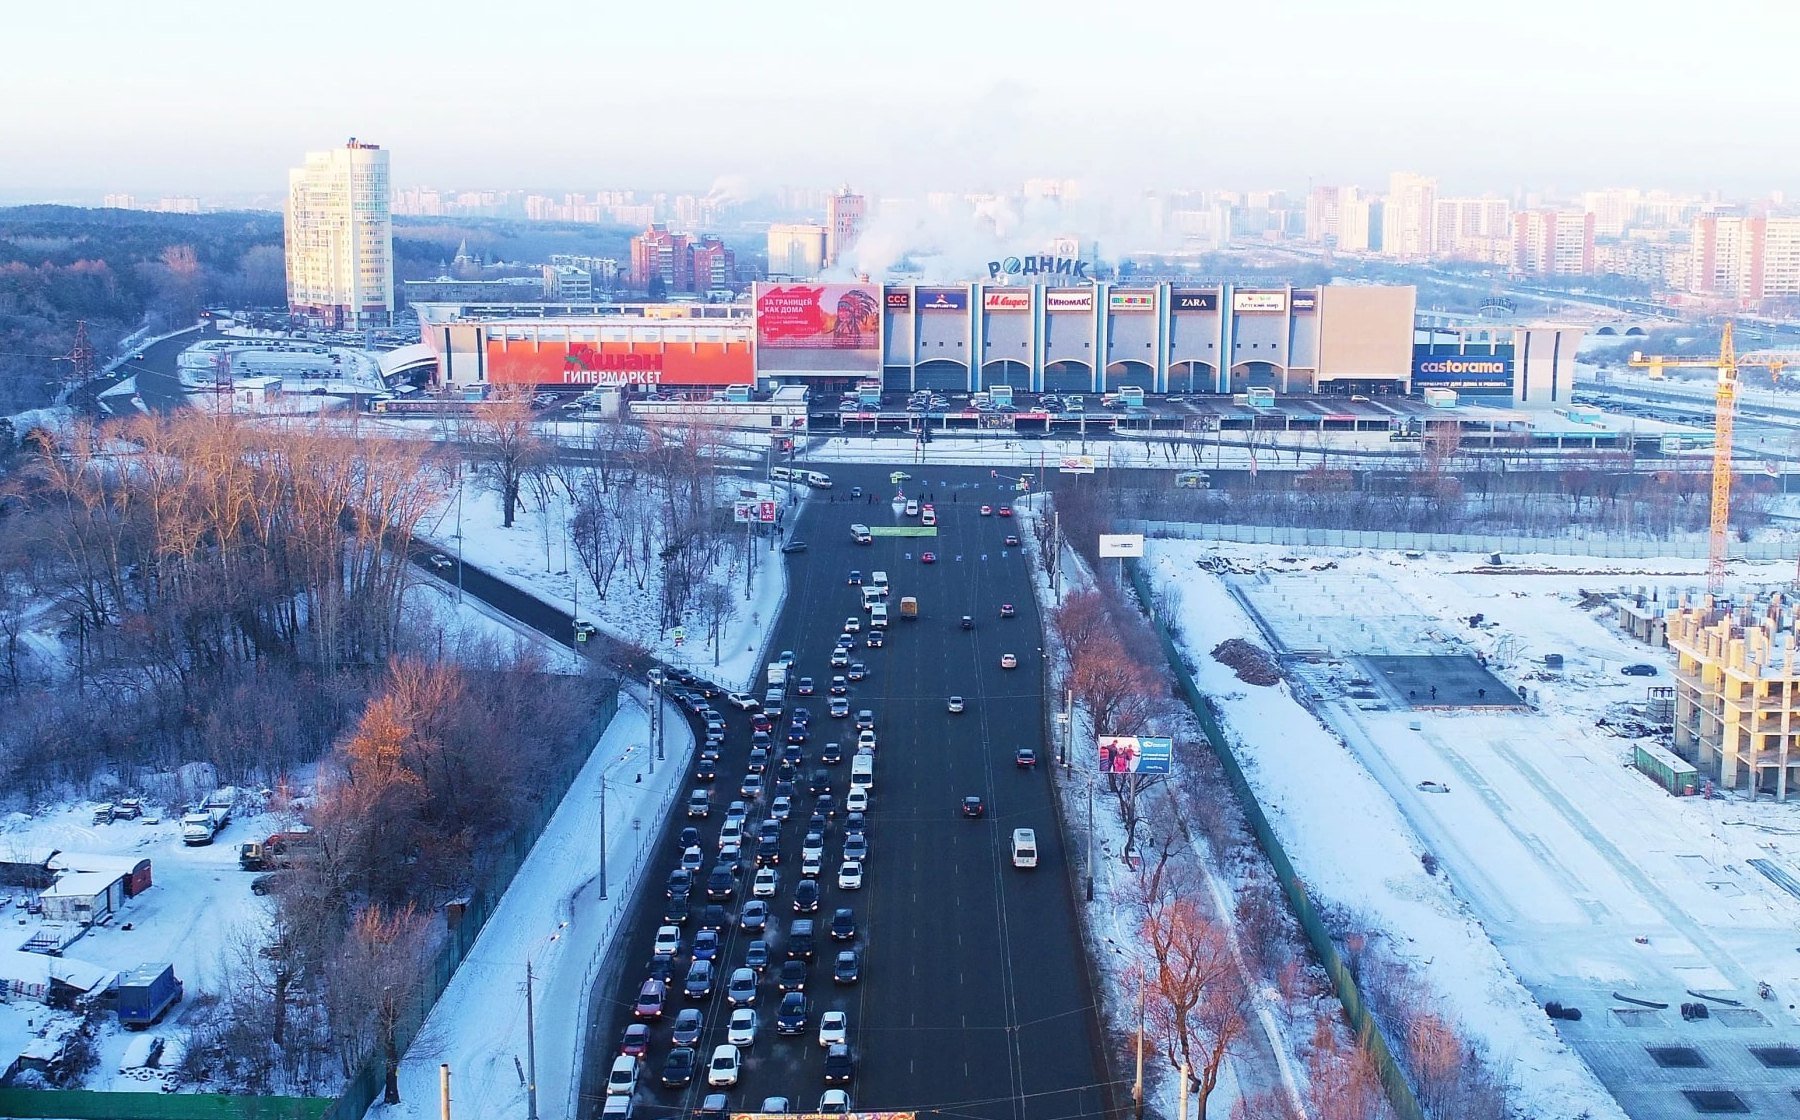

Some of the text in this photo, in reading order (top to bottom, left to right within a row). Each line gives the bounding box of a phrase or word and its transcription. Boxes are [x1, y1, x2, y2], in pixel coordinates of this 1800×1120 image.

[987, 256, 1089, 279] РОДНИК
[765, 297, 812, 307] ЗА ГРАНИЦЕЙ
[1181, 298, 1207, 307] ZARA
[780, 306, 803, 314] ДОМА
[1420, 359, 1504, 374] castorama
[563, 371, 662, 384] ГИПЕРМАРКЕТ
